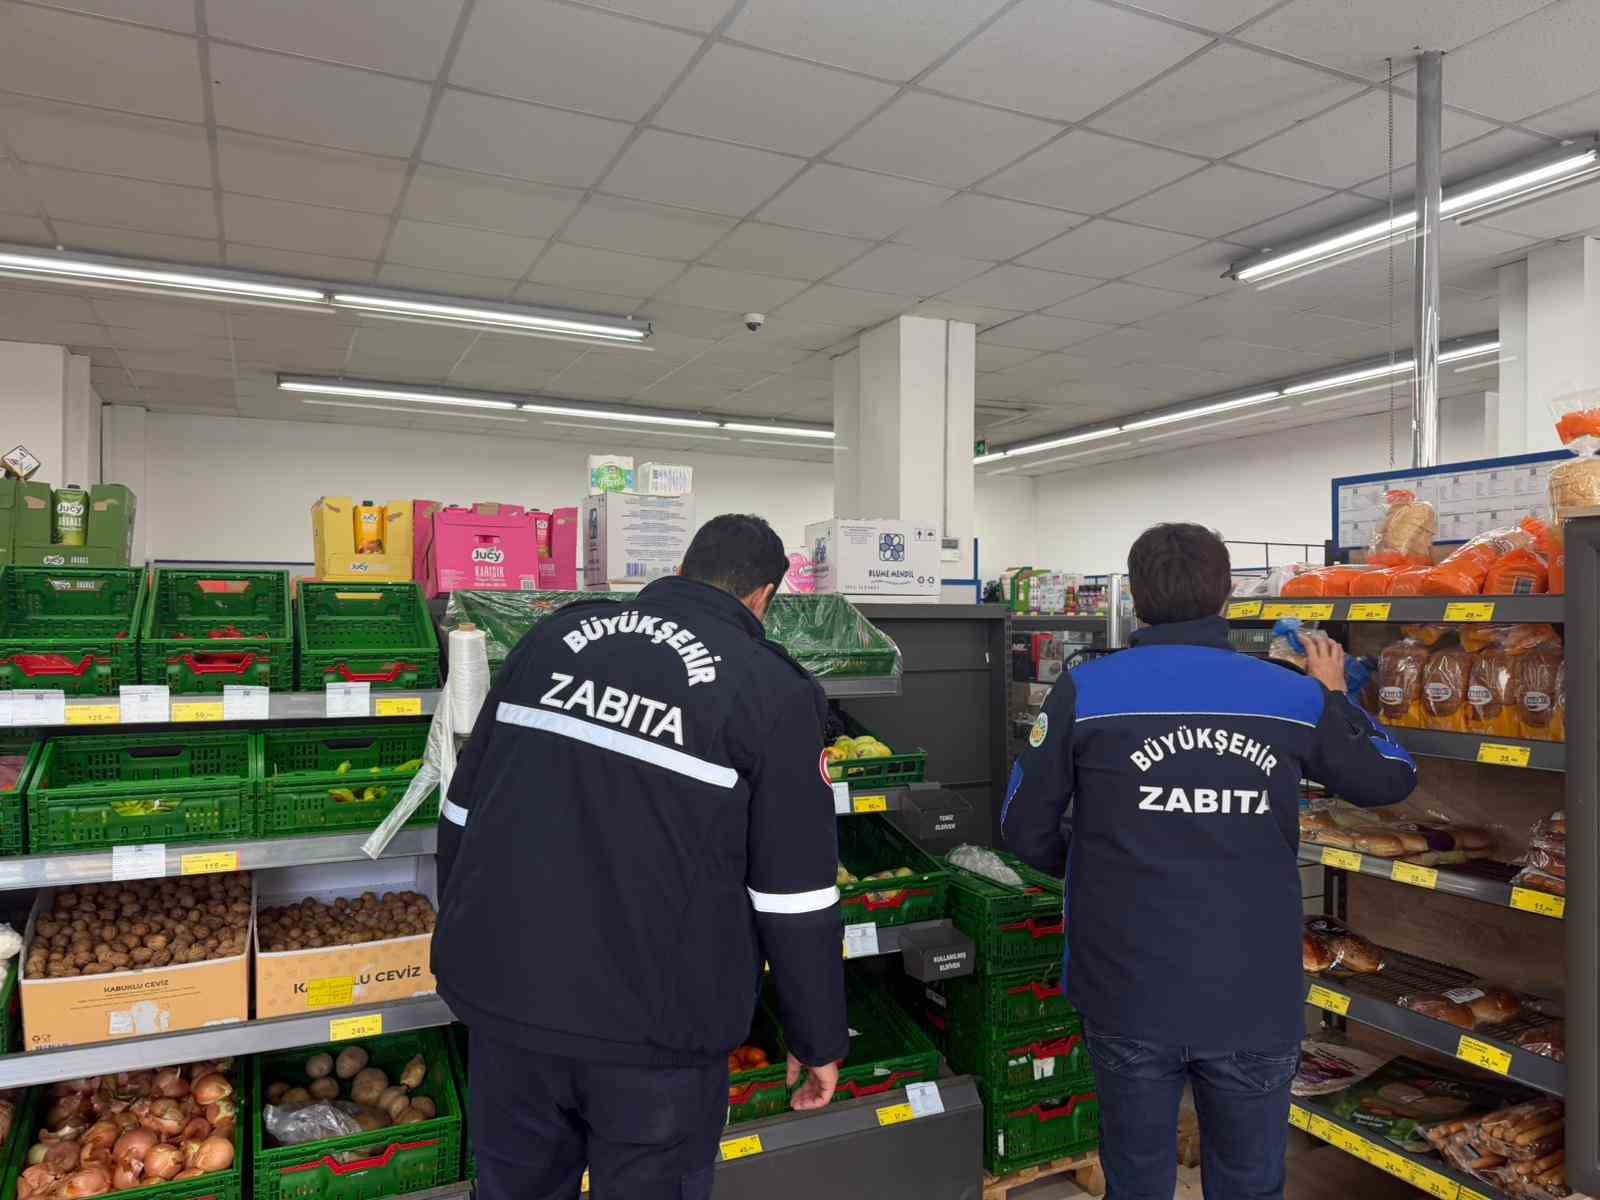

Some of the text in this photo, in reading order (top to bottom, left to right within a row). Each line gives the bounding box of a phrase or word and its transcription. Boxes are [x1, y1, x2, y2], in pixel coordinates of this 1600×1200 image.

[474, 548, 502, 562] Jucy
[562, 610, 722, 687] BÜYÜKŞEHİR
[539, 672, 684, 746] ZABITA
[1129, 724, 1278, 777] BÜYÜKŞEHİR
[1138, 785, 1271, 815] ZABITA
[375, 965, 421, 982] CEVİZ
